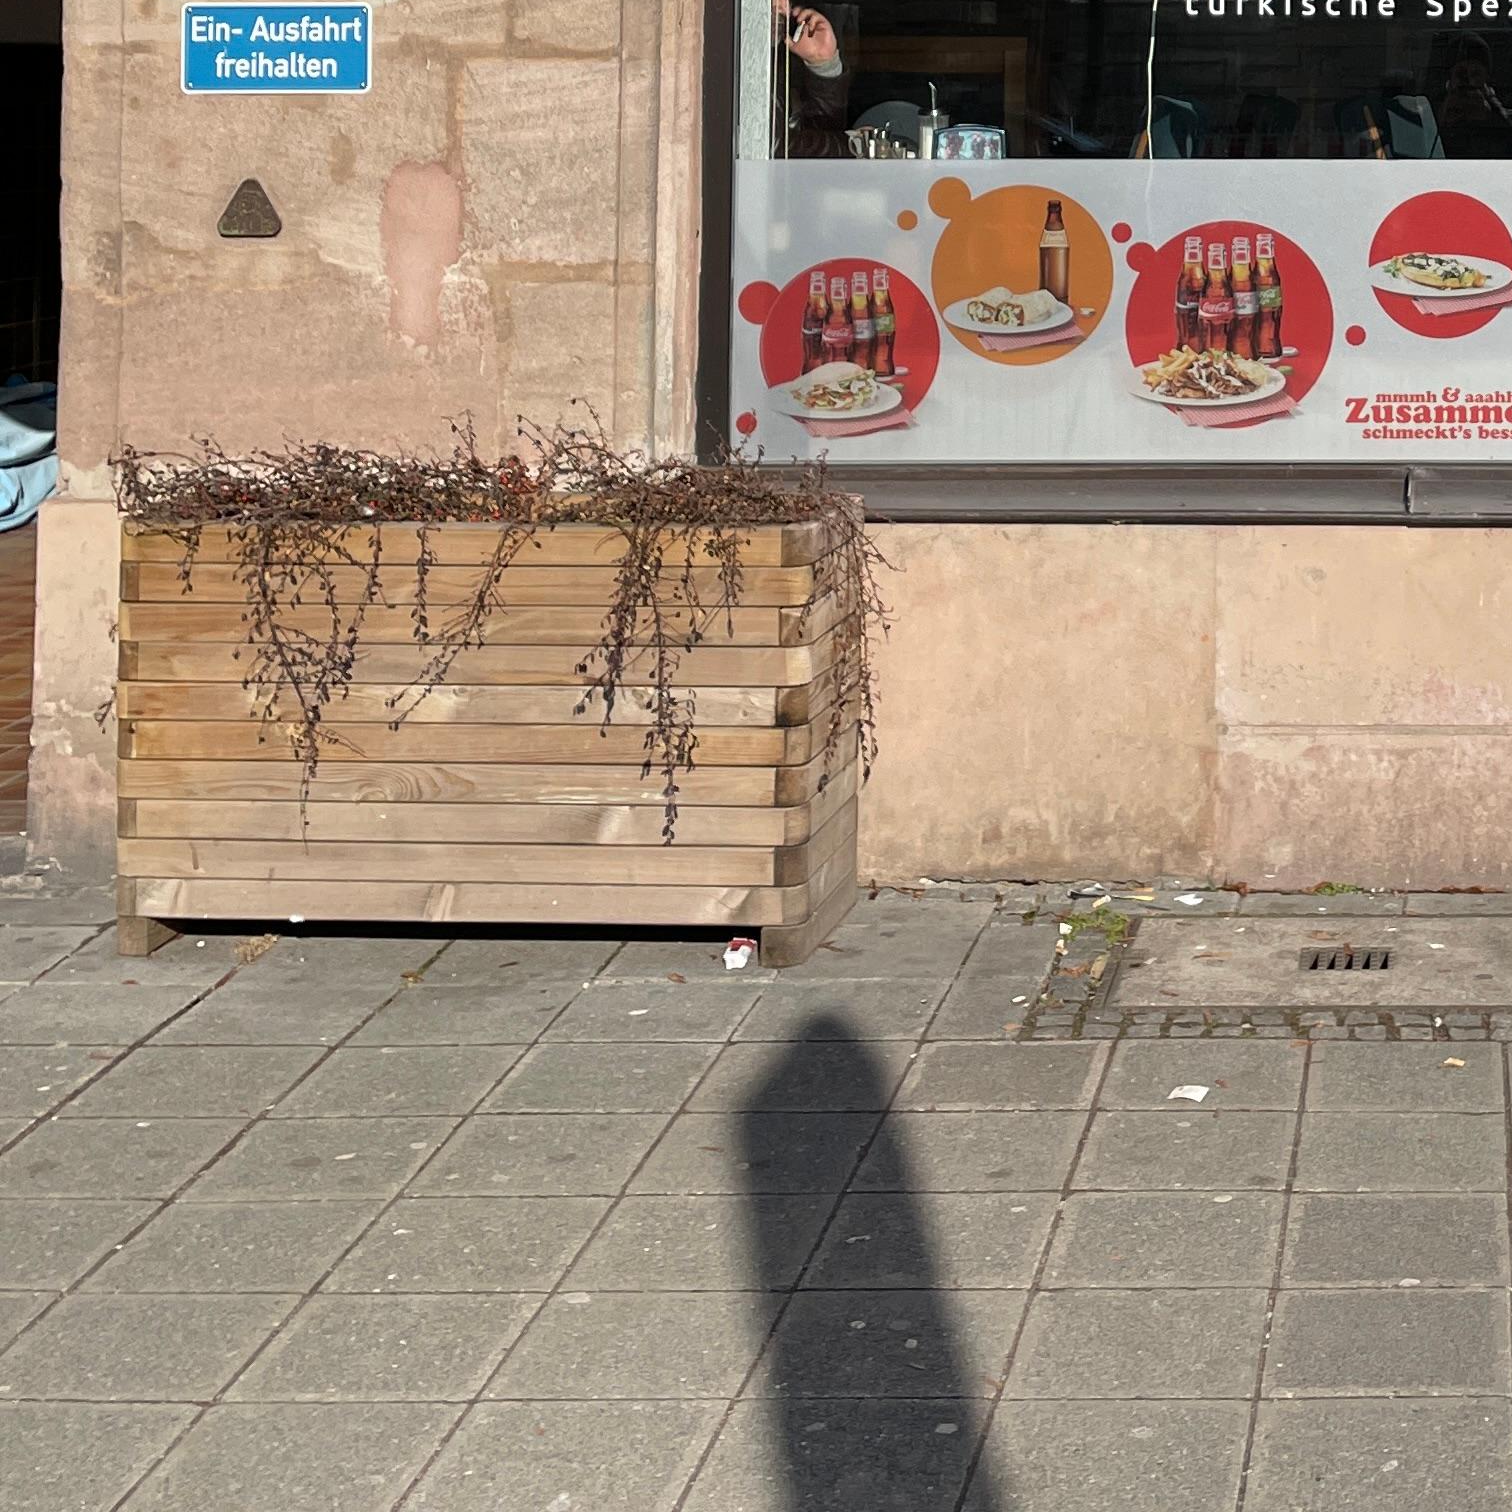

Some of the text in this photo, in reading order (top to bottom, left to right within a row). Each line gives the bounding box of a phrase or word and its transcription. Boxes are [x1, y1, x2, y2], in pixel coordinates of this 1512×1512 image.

[192, 16, 362, 42] Ein- Ausfahrt
[215, 52, 337, 78] freihalten
[1376, 391, 1436, 403] mmmh
[1441, 387, 1461, 403] &
